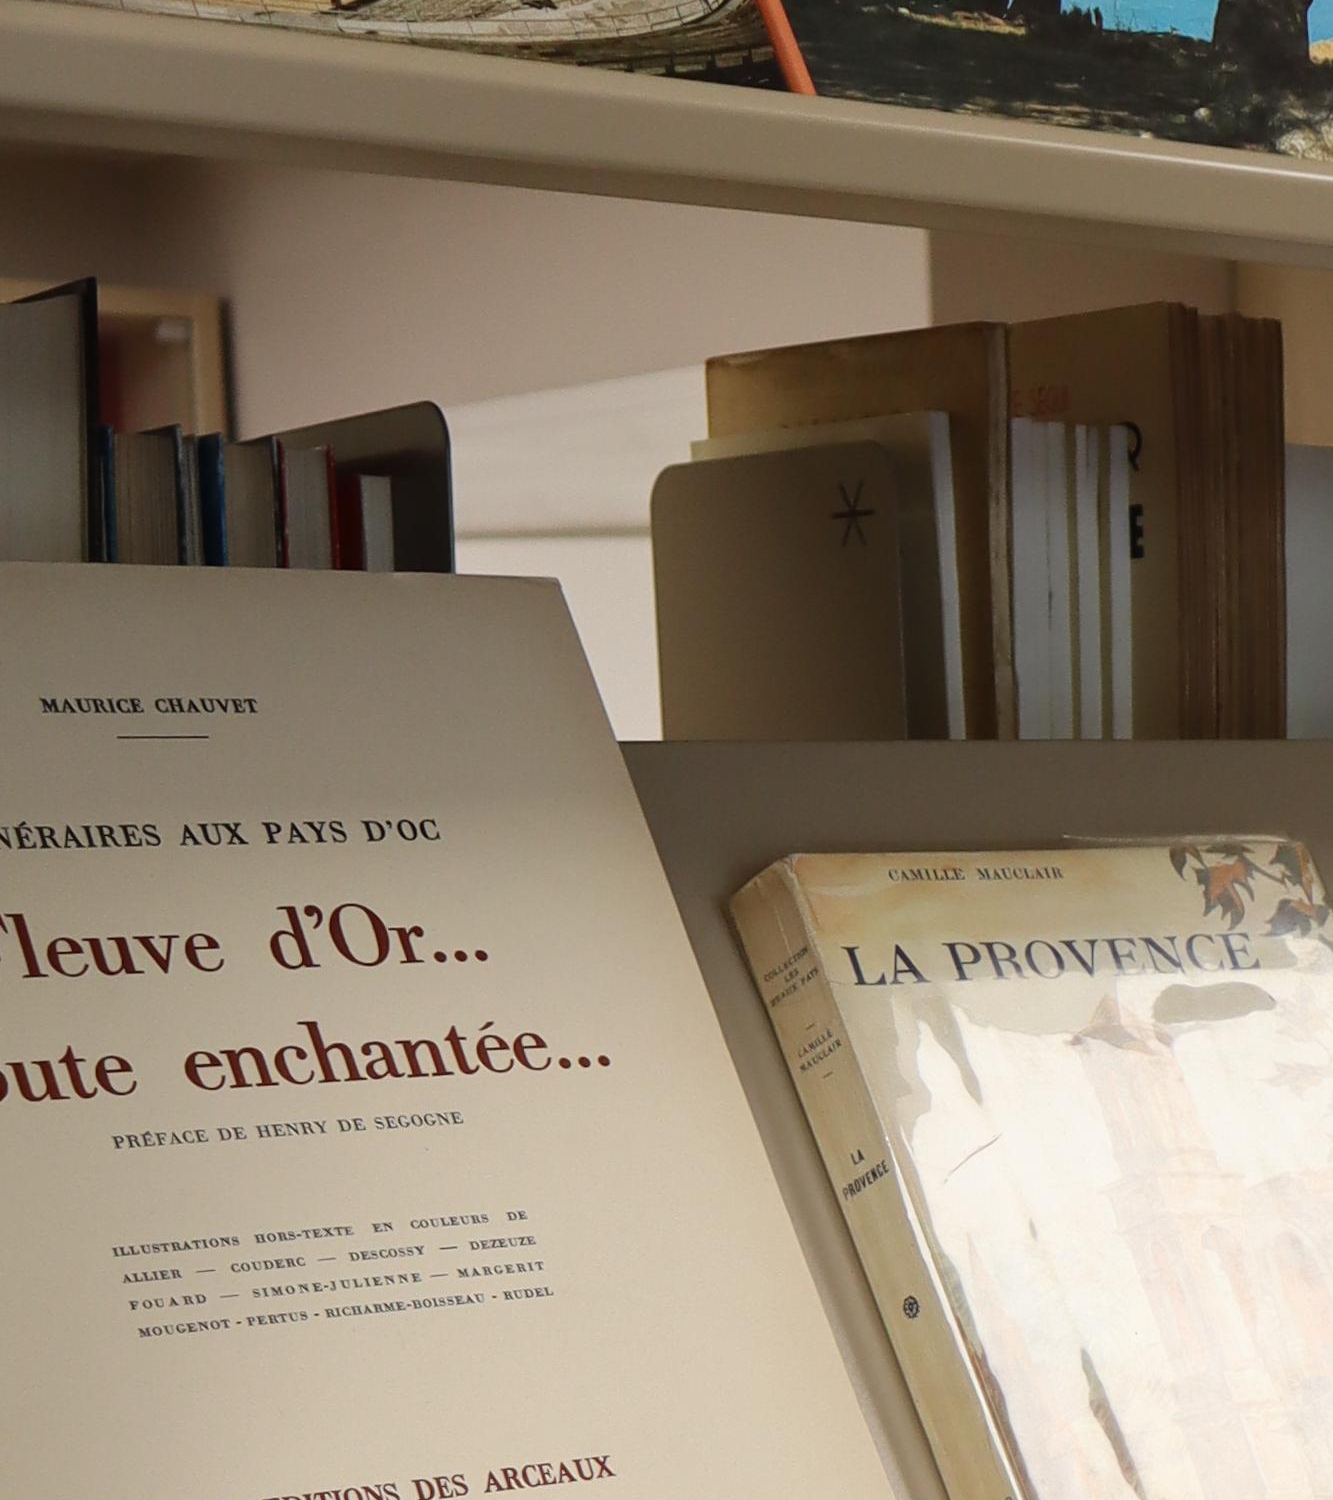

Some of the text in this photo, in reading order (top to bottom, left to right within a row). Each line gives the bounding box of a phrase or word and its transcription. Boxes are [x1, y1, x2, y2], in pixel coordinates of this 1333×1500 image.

[41, 698, 258, 714] MAURICE CHAUVET
[179, 822, 249, 846] AUX
[265, 821, 348, 845] PAYS
[363, 818, 441, 842] D'OC
[888, 867, 1064, 882] CAMILLE MAUCLAIR
[0, 903, 488, 979] leuve d'Or...
[840, 932, 1262, 986] LA PROVENCE
[185, 1021, 611, 1091] enchantée...
[112, 1111, 464, 1150] PRÉFACE DE HENRY DE SEGOGNE
[850, 1149, 865, 1165] LA
[842, 1159, 890, 1201] PROVENCE
[112, 1210, 528, 1258] ILLUSTRATIONS HORS-TEXTE EN COULEURS DE
[137, 1286, 554, 1338] MOUGENOT PERTUS RICHARME-BOISSEAU RUDEL
[483, 1455, 617, 1494] ARCEAUX
